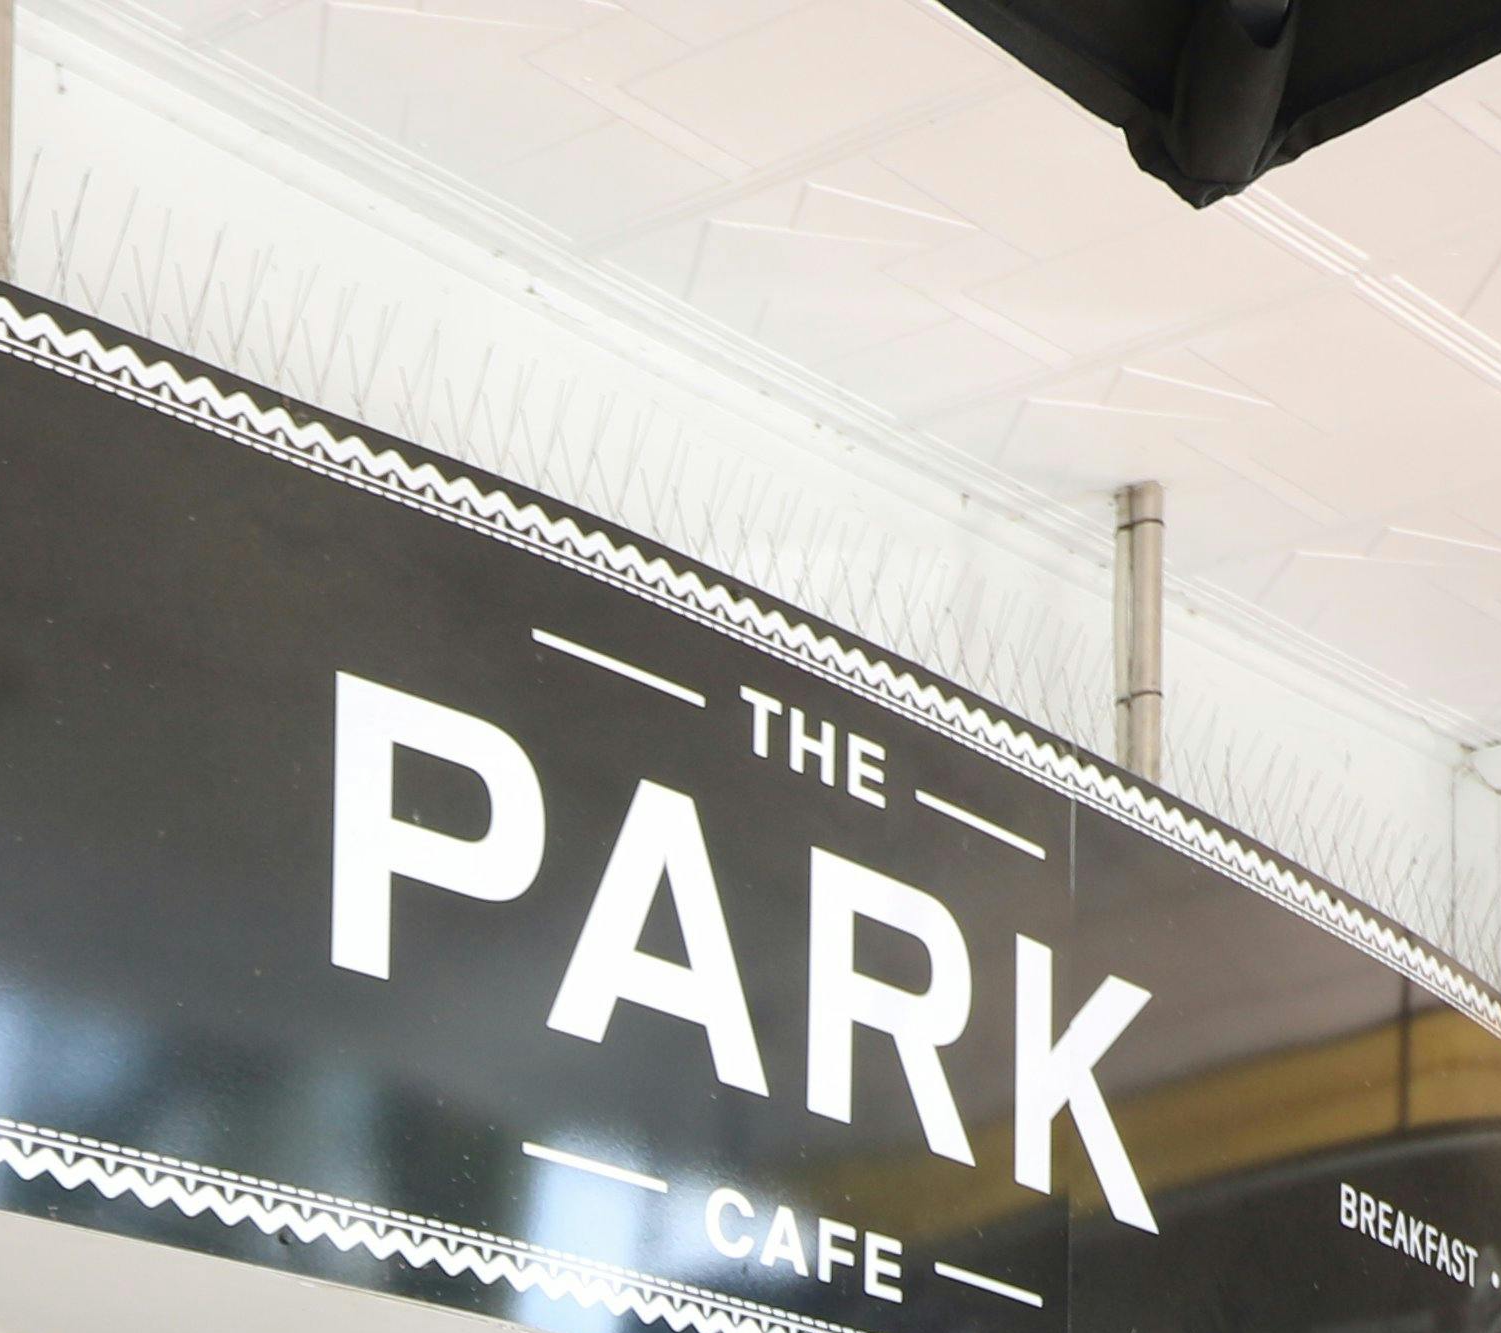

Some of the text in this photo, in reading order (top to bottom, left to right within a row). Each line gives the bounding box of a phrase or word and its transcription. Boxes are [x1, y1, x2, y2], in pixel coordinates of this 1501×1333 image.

[740, 685, 887, 808] THE
[330, 671, 1159, 1235] PARK
[704, 1188, 903, 1304] CAFE
[1340, 1182, 1478, 1287] BREAKFAST
